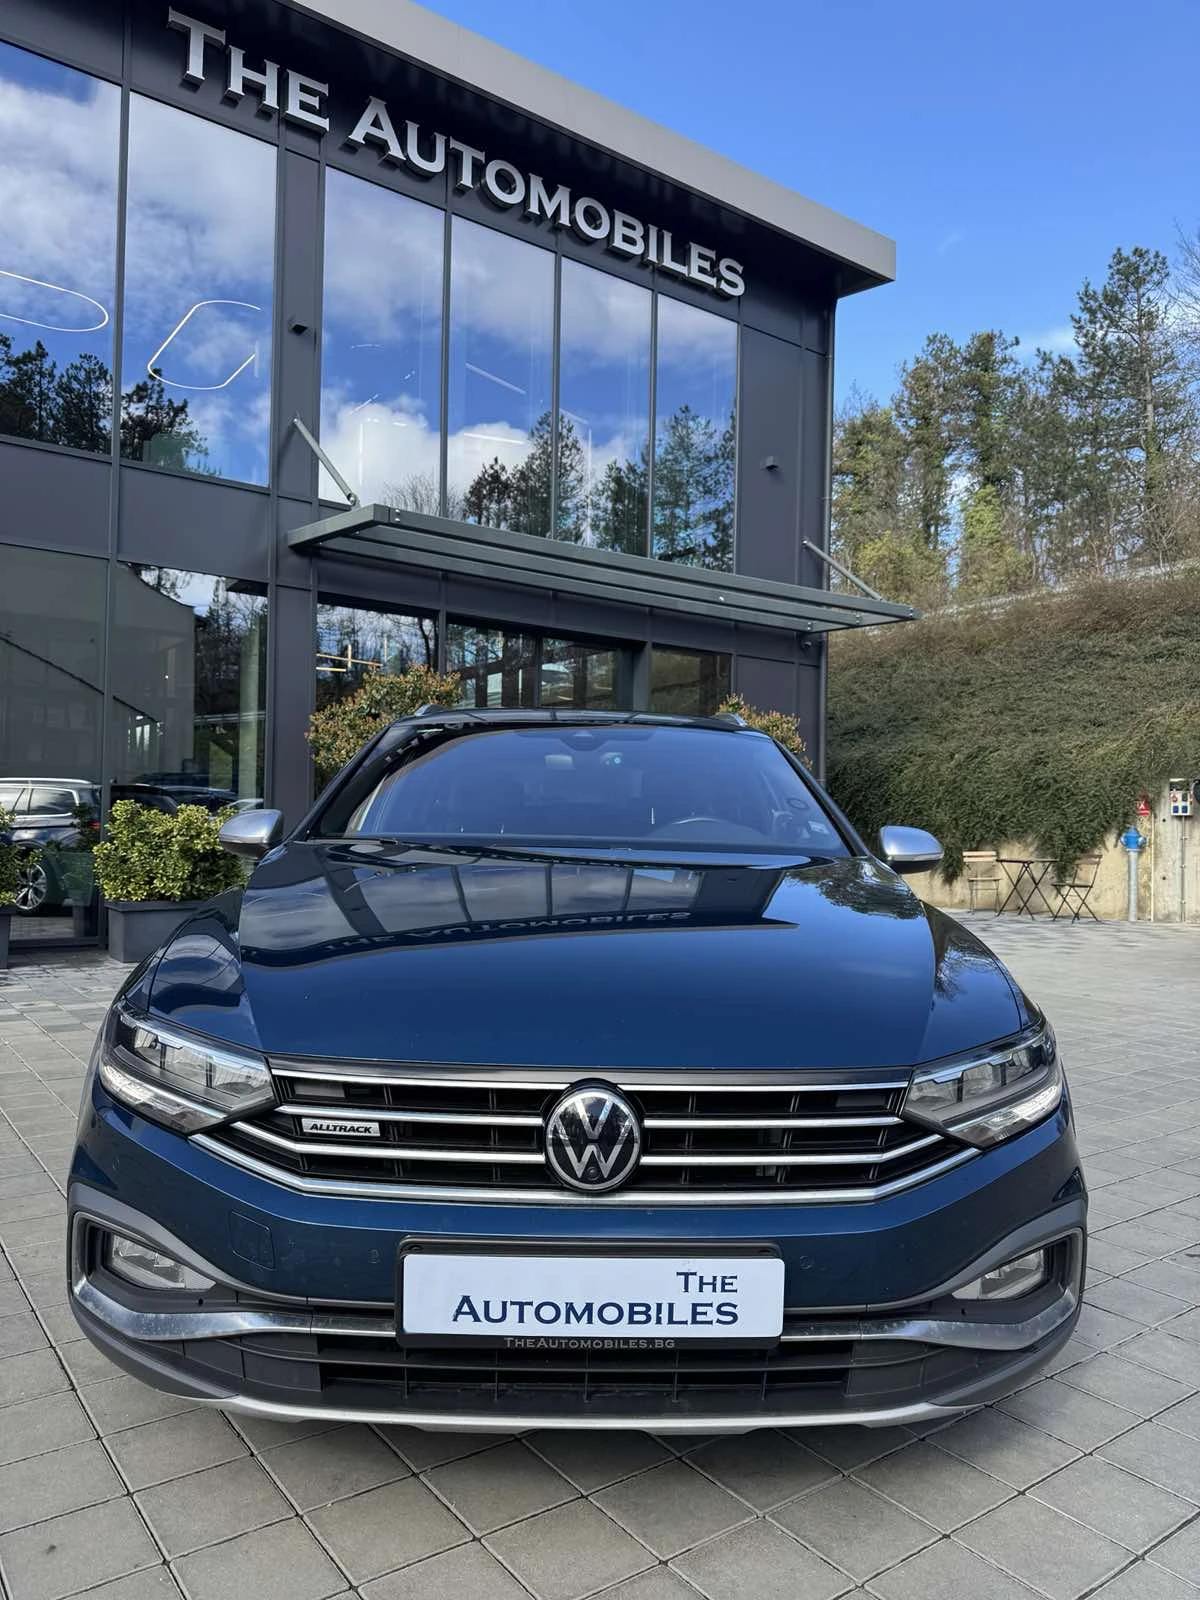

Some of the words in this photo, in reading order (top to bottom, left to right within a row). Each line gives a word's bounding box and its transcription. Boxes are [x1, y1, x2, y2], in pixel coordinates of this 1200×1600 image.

[168, 6, 330, 133] THE
[348, 95, 746, 297] AUTOMOBILES
[310, 1123, 373, 1134] ALLTRACK
[552, 1095, 636, 1180] VW
[676, 1271, 738, 1293] THE
[452, 1295, 739, 1325] AUTOMOBILES
[504, 1337, 676, 1349] THEAUTOMOBILES.BG
